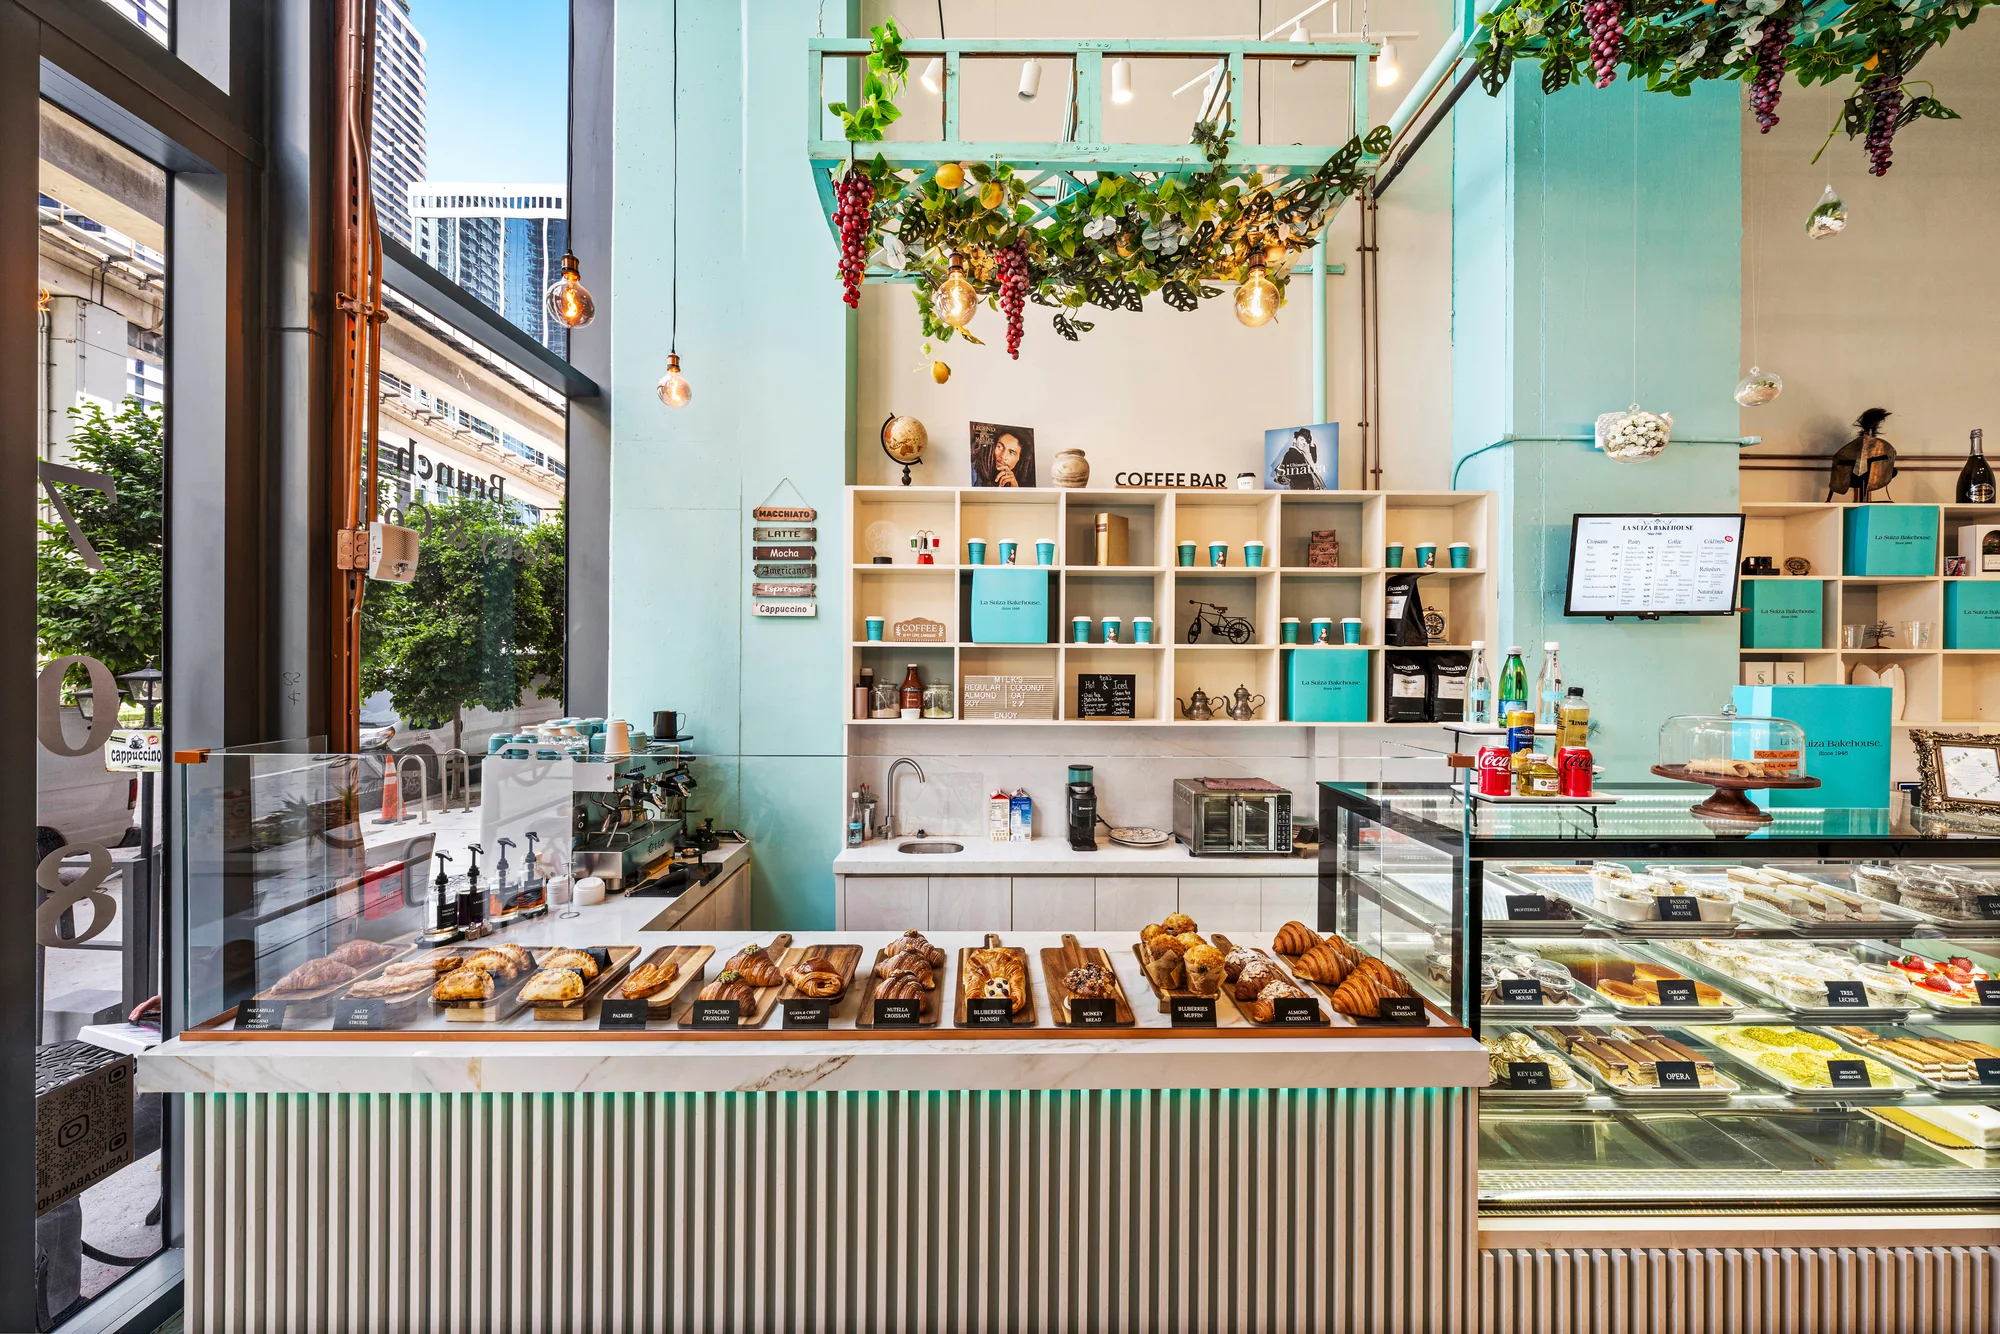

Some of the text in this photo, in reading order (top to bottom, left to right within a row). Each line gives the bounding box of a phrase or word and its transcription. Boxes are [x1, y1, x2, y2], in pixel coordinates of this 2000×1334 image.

[1276, 462, 1327, 477] Sinatra
[1115, 472, 1227, 488] COFFEE BAR
[758, 510, 810, 518] MACCHIATO
[767, 530, 801, 538] LATTE
[769, 548, 799, 558] Mocha
[761, 566, 807, 576] Americano
[764, 584, 804, 596] Espresso
[759, 604, 808, 614] Cappuccino
[901, 623, 938, 633] COFFEE
[964, 683, 1001, 691] REGULAR
[1010, 684, 1046, 692] COCONUT
[1112, 679, 1129, 690] Iced
[993, 711, 1018, 719] ENJOY
[110, 746, 162, 763] cappuccino
[1665, 1072, 1691, 1080] OPERA
